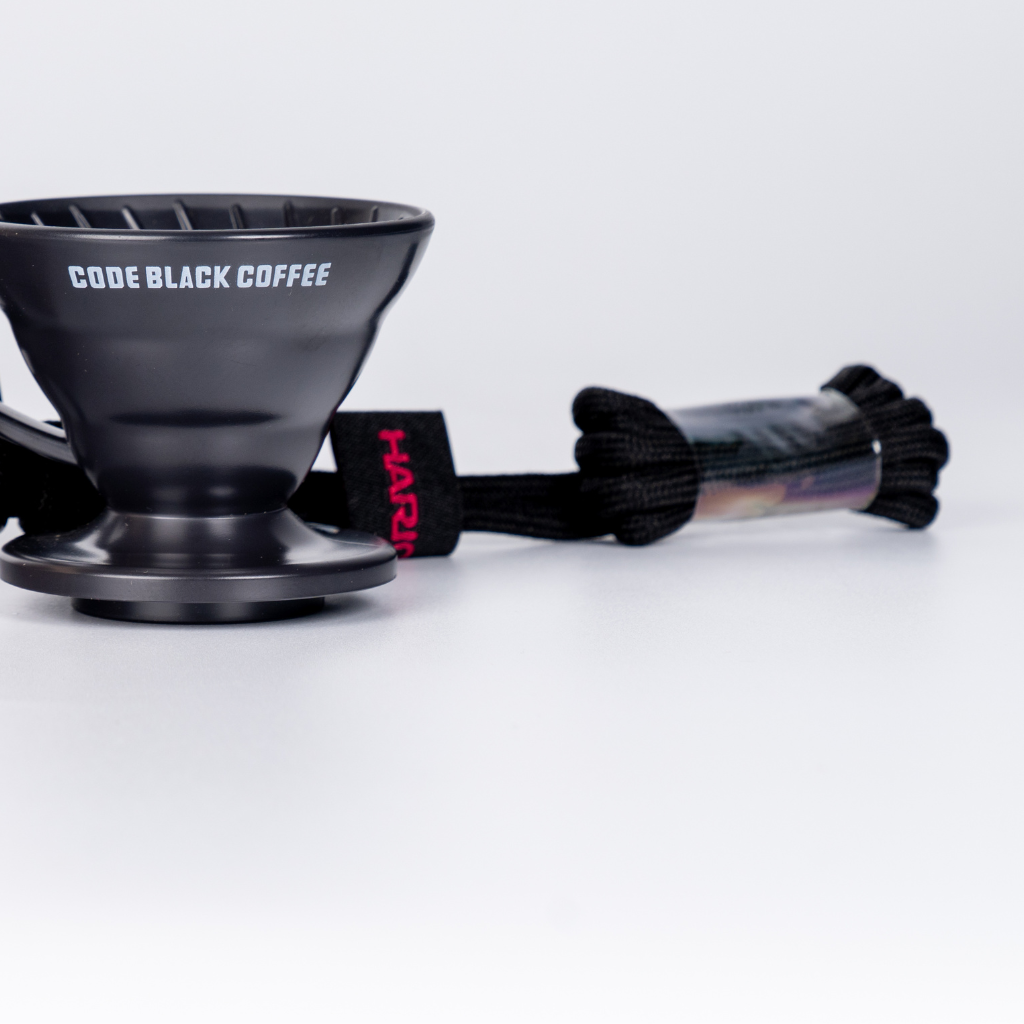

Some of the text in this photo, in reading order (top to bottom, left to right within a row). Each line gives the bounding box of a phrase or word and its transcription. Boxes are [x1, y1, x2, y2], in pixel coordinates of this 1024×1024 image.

[68, 262, 332, 289] CODE BLACK COFFEE
